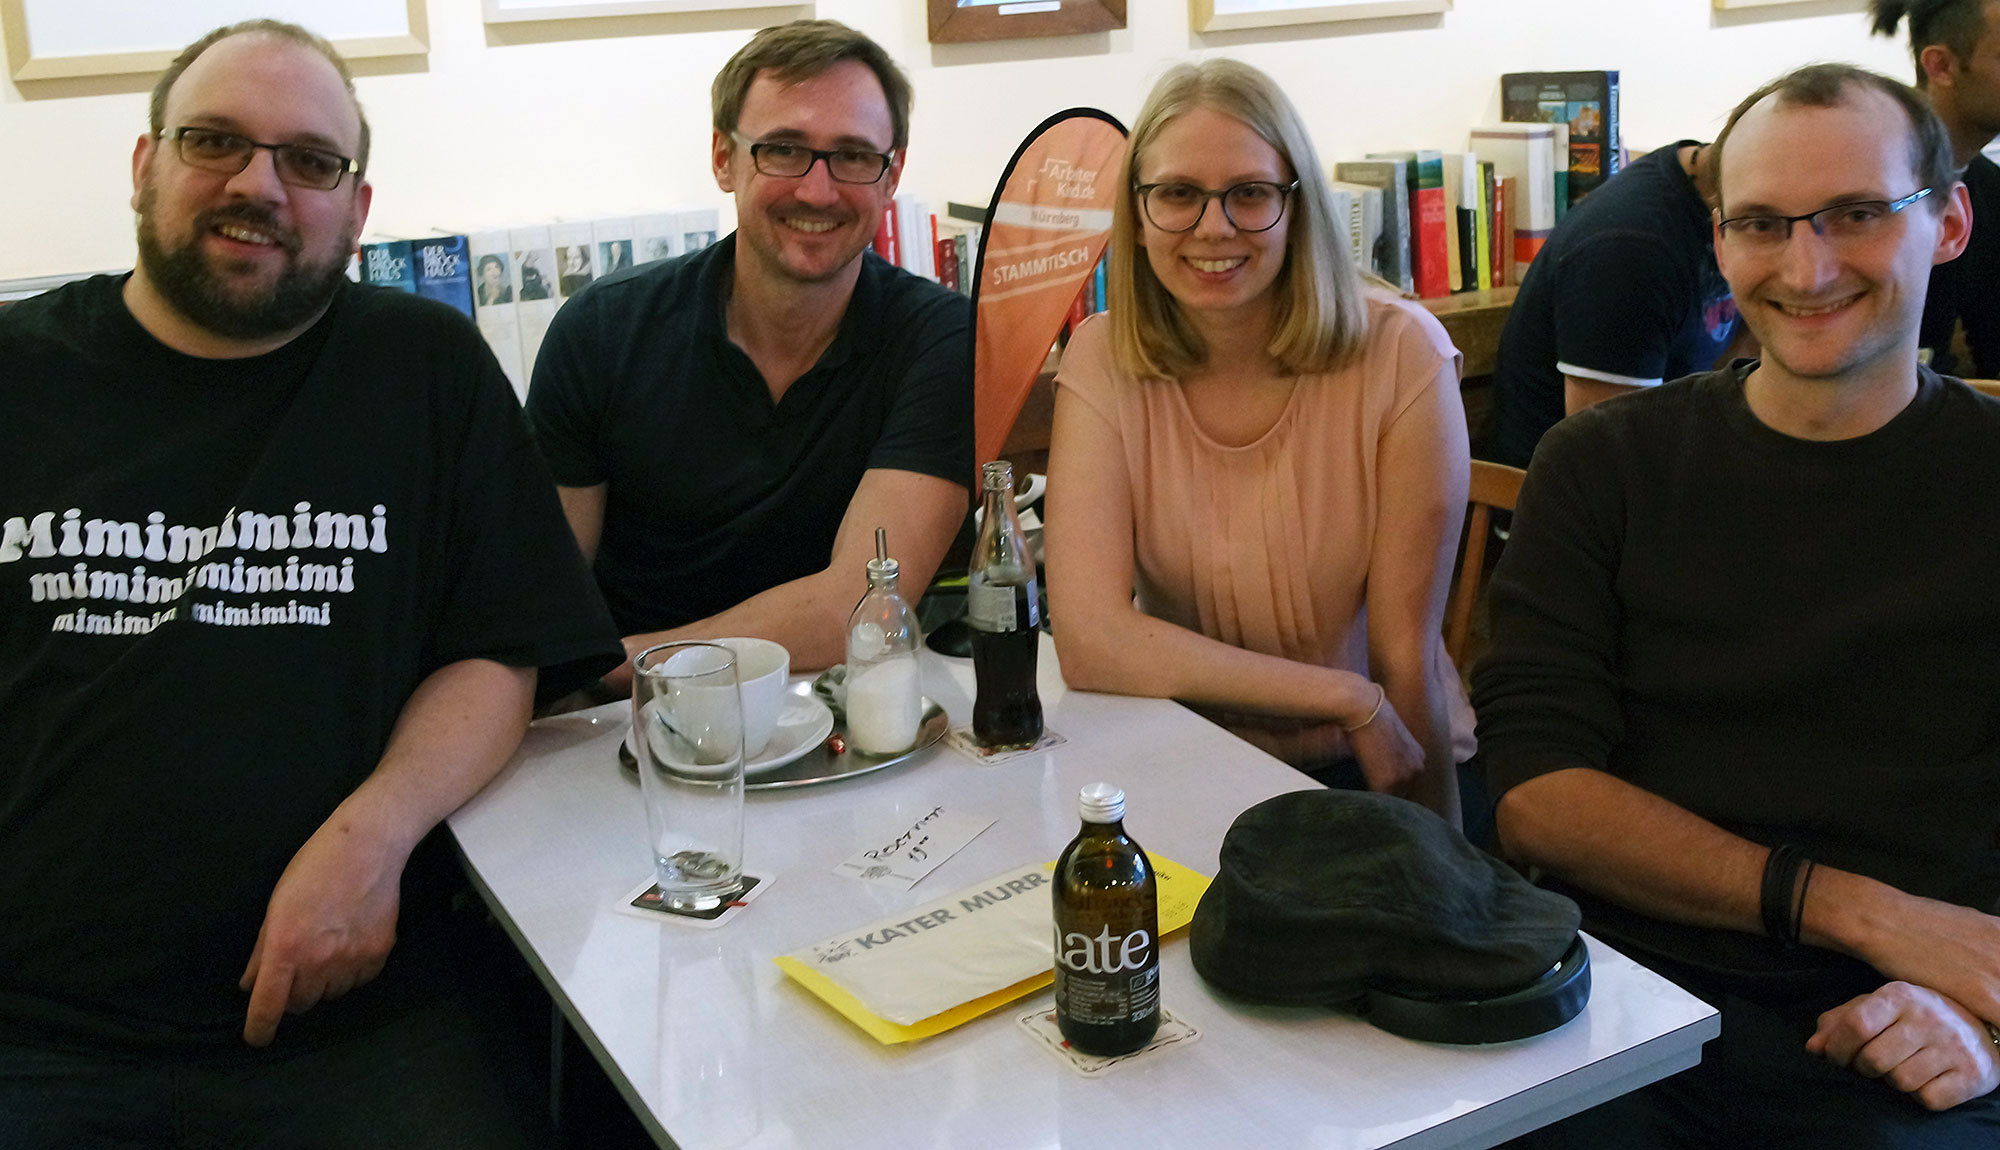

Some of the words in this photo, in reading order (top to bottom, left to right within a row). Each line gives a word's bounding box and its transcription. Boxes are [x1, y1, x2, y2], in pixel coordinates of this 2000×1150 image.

[1031, 210, 1080, 228] Nürnberg
[993, 246, 1089, 285] STAMMTISCH
[855, 909, 957, 951] KATER
[959, 872, 1049, 914] MURR
